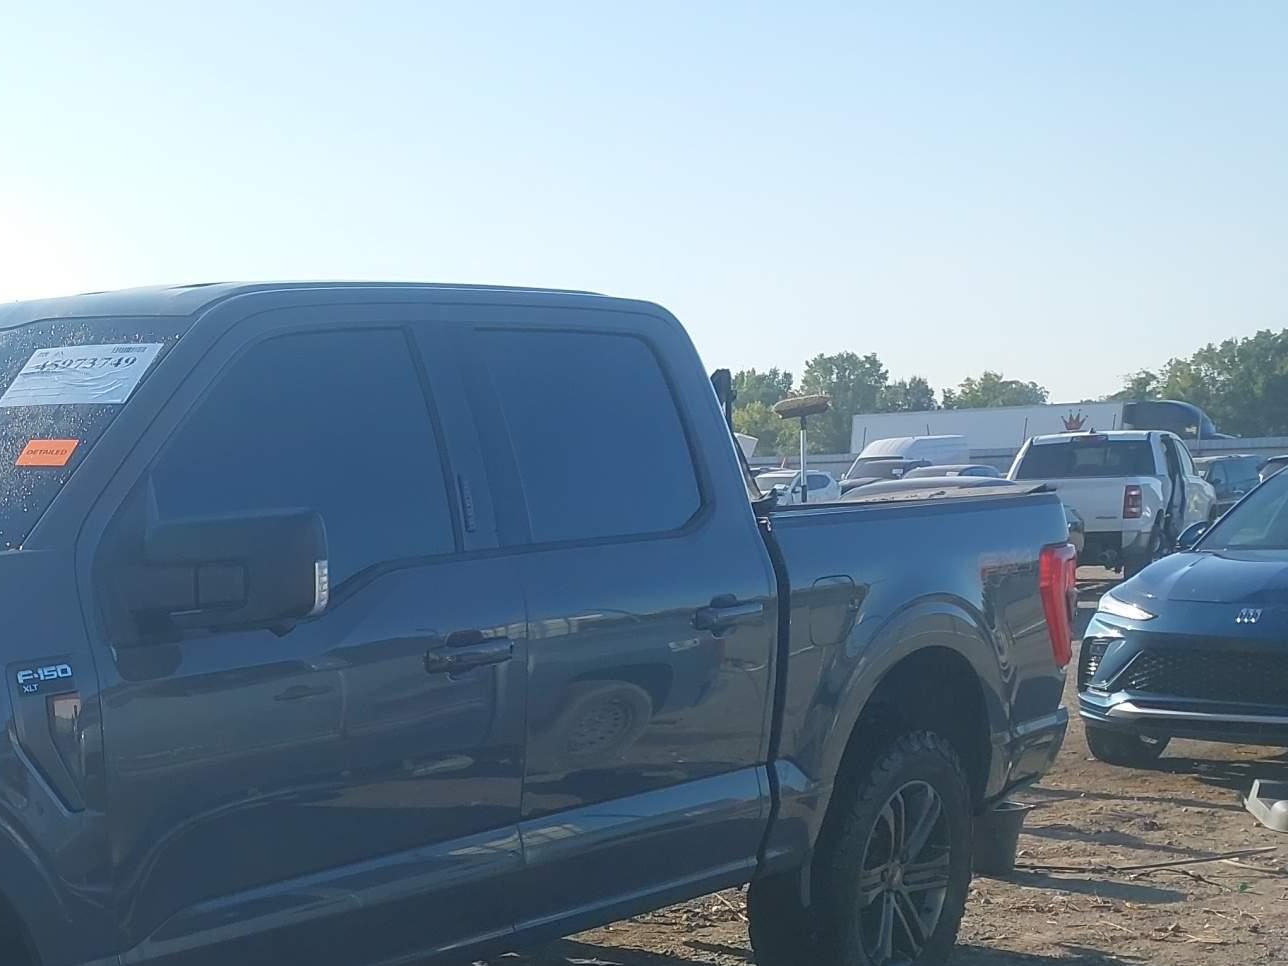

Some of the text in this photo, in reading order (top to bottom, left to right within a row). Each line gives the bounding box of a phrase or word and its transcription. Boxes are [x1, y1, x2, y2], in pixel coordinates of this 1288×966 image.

[33, 356, 137, 371] 45973749
[17, 663, 72, 684] F-150
[23, 683, 39, 693] XLT
